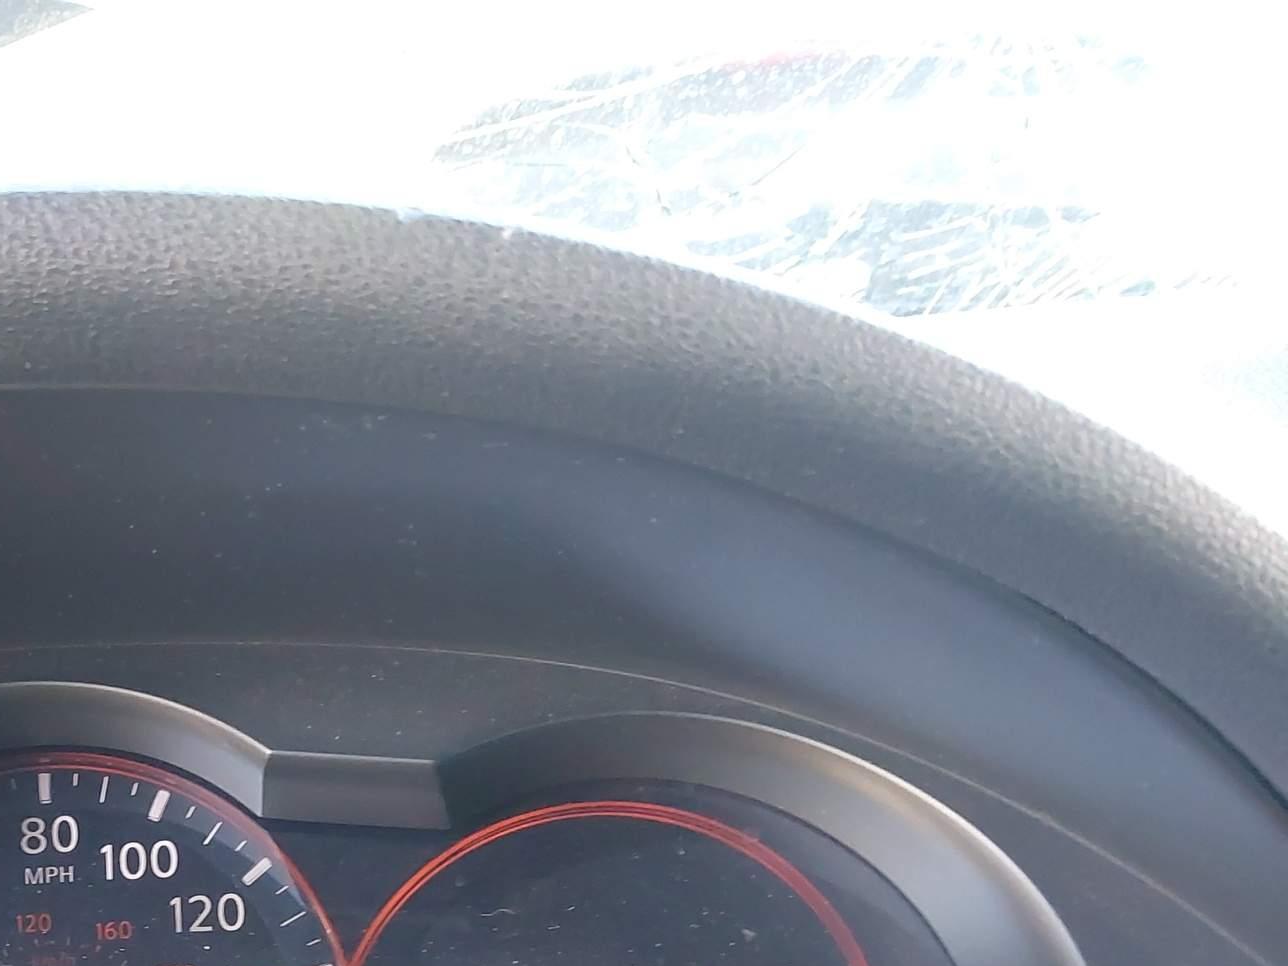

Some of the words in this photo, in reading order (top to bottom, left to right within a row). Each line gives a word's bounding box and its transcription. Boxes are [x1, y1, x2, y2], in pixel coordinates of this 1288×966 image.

[20, 815, 79, 854] 80
[25, 866, 74, 885] MPH
[100, 841, 179, 880] 100
[16, 914, 52, 934] 120
[170, 894, 245, 933] 120
[96, 920, 133, 941] 160
